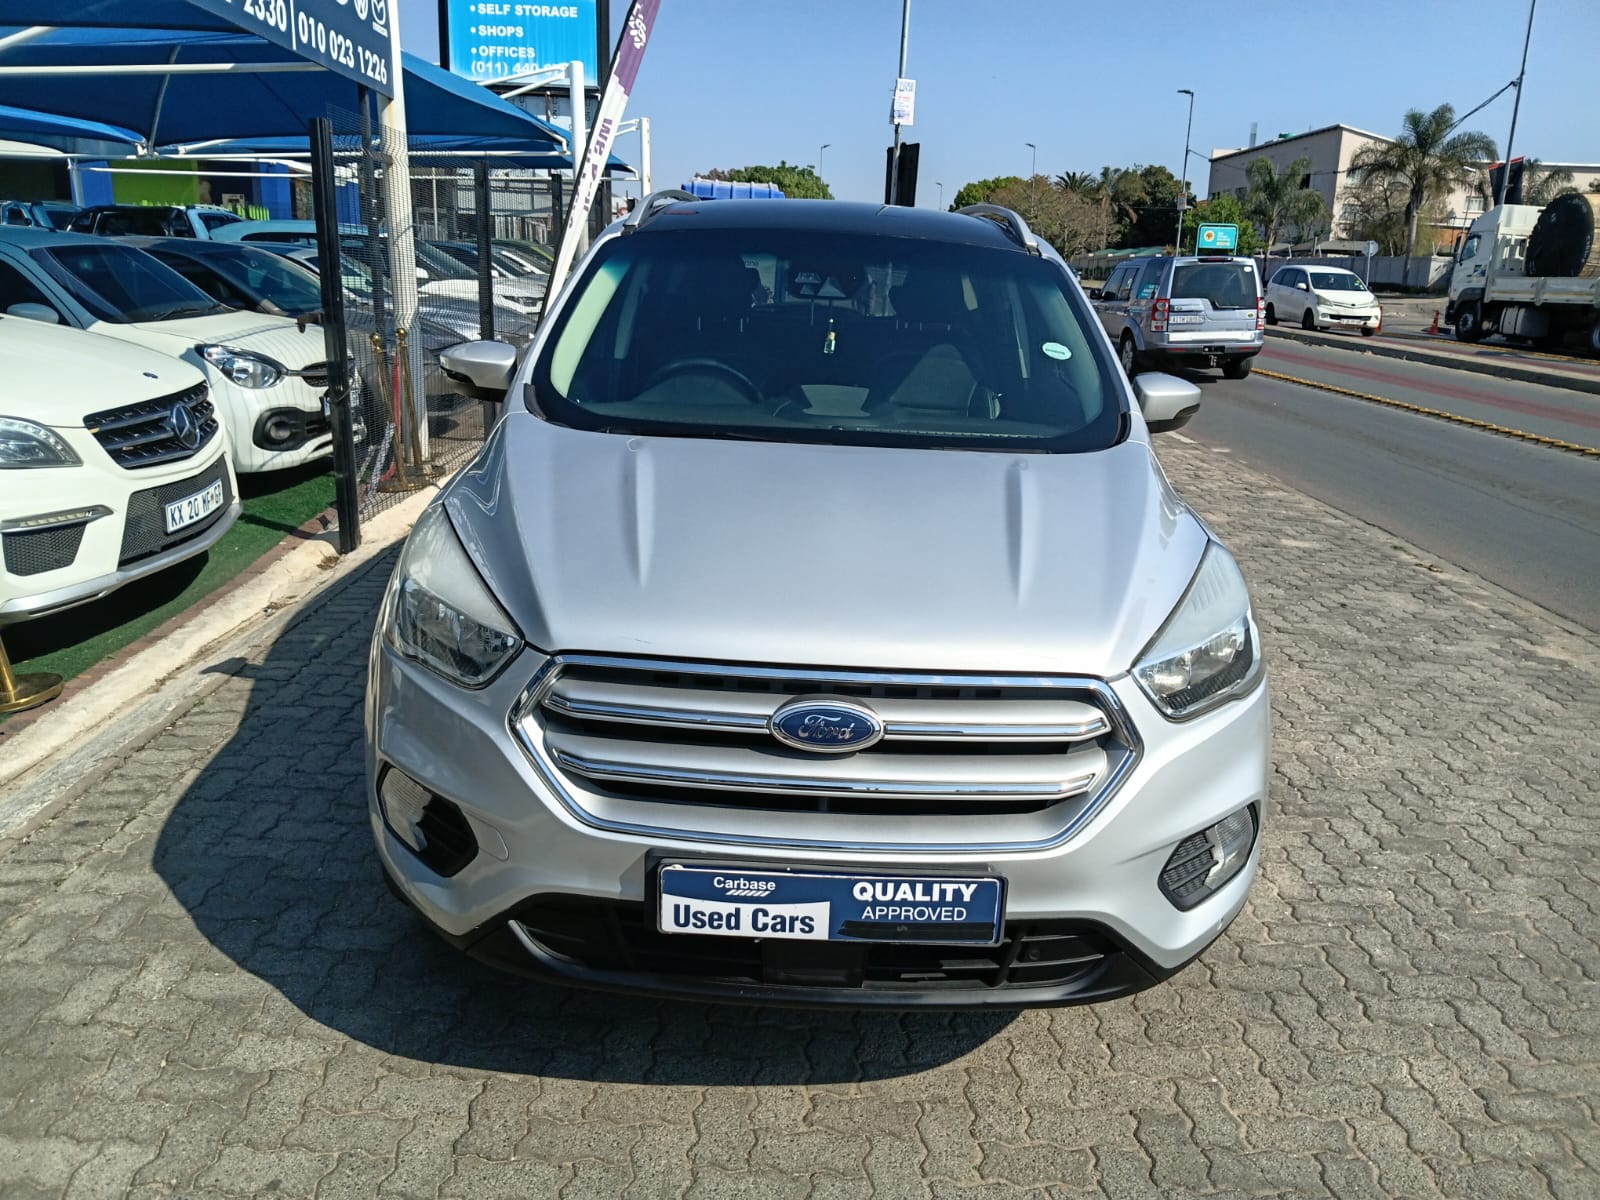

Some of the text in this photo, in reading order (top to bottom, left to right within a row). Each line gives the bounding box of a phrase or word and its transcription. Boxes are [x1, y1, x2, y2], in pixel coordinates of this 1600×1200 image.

[478, 4, 578, 18] SELF STORAGE
[478, 25, 524, 38] SHOPS
[244, 0, 287, 32] 2330
[298, 11, 326, 53] 010
[329, 30, 355, 68] 023
[357, 46, 388, 85] 1226
[479, 46, 536, 58] OFFICES
[471, 61, 508, 75] (011)
[170, 504, 184, 527] KX
[798, 714, 856, 740] Ford
[713, 876, 776, 892] Carbase
[852, 881, 978, 903] QUALITY
[673, 903, 815, 935] Used Cars
[862, 906, 967, 922] APPROVED
